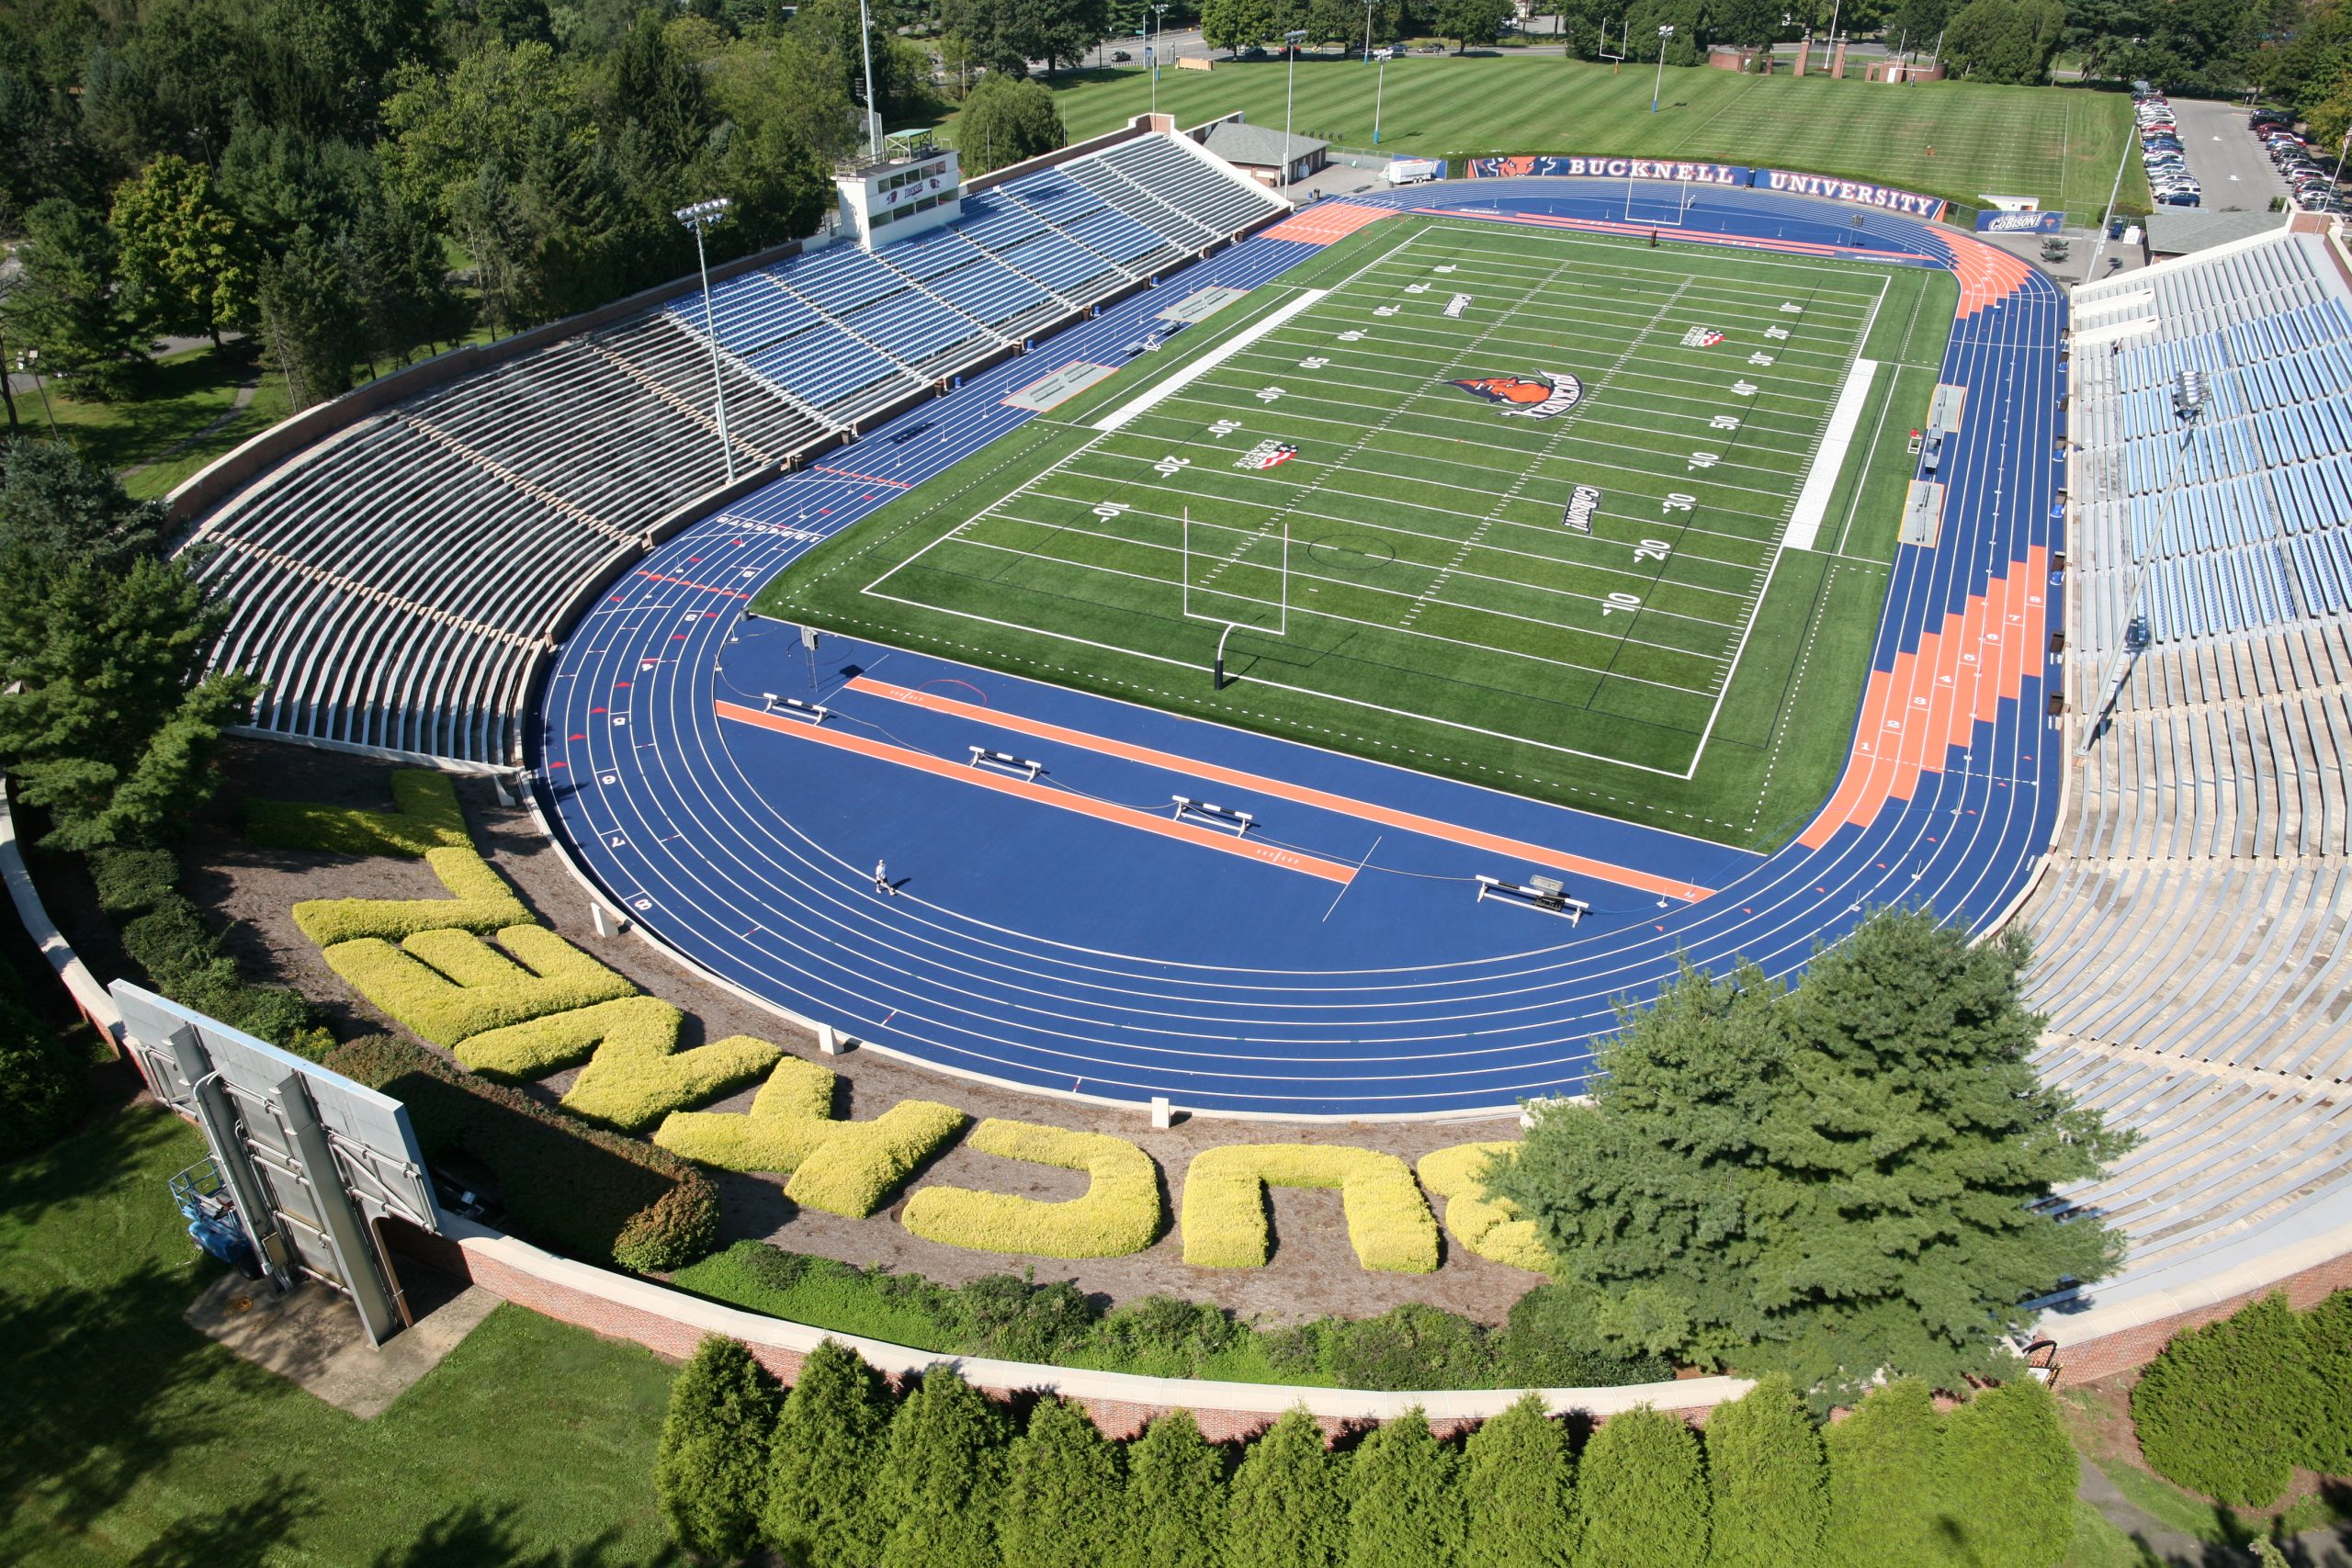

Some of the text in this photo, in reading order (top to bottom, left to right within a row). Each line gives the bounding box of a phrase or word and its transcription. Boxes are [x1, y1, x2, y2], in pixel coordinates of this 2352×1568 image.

[1568, 158, 1933, 217] BUCKNELL UNIVERSITY
[1764, 328, 1789, 340] 20
[1298, 356, 1330, 368] 50
[1747, 355, 1774, 366] 30
[1255, 387, 1286, 400] 40
[1501, 370, 1580, 418] BUCKNELL
[1730, 382, 1758, 396] 40
[1207, 419, 1242, 434] 30
[1710, 415, 1739, 430] 50
[1154, 456, 1191, 472] 20
[1688, 452, 1719, 468] 40
[1662, 492, 1696, 511] 30
[1092, 502, 1130, 516] 10
[1634, 539, 1670, 560] 20
[1602, 592, 1641, 612] 10
[684, 614, 697, 622] 3
[1986, 633, 1999, 641] 6
[1963, 653, 1975, 661] 5
[642, 663, 653, 671] 4
[1939, 675, 1951, 683] 4
[1914, 696, 1928, 705] 3
[613, 717, 626, 726] 5
[1887, 719, 1900, 728] 2
[1860, 742, 1871, 750] 1
[602, 774, 616, 784] 6
[612, 837, 626, 848] 7
[635, 898, 652, 910] 8
